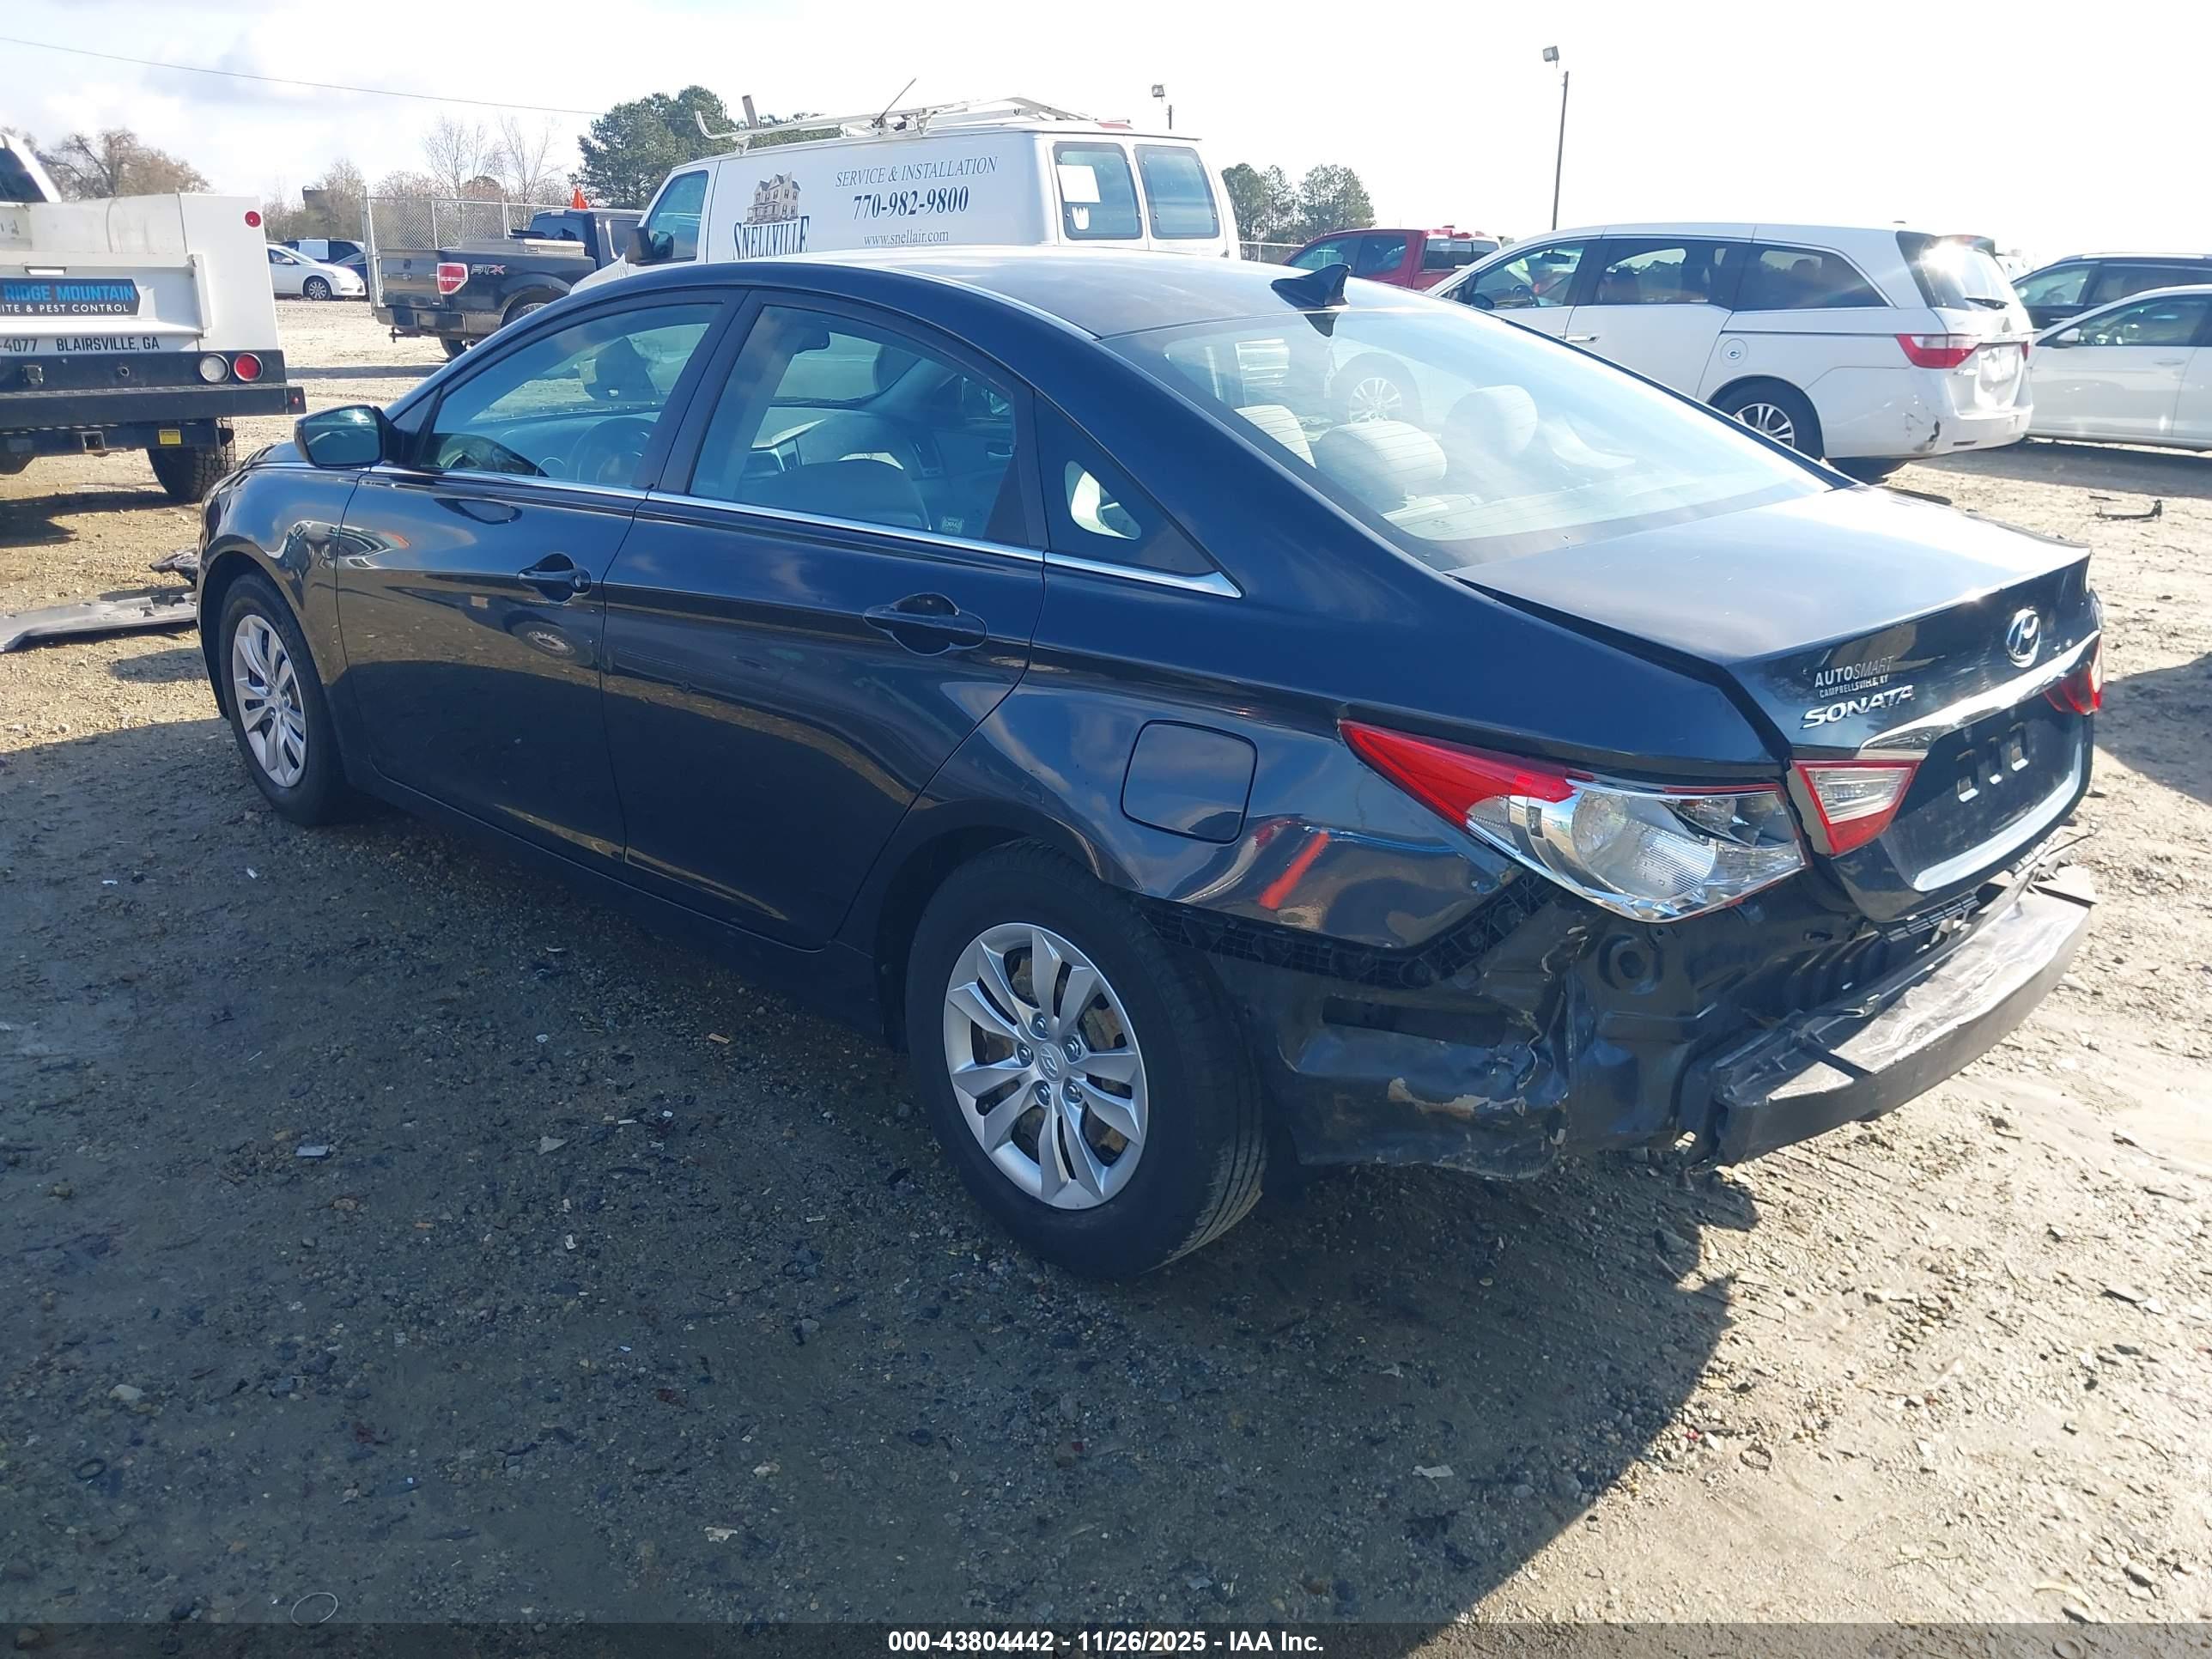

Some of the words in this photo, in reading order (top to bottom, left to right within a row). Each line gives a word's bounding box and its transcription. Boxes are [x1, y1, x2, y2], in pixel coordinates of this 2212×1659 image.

[836, 167, 886, 187] SERVICE
[888, 166, 898, 183] &
[901, 156, 999, 182] INSTALLATION
[853, 185, 969, 221] 770-982-9800
[732, 215, 811, 261] SNELLVILLE
[863, 228, 950, 247] www.snellair.com
[470, 264, 507, 276] STX
[3, 284, 52, 301] RIDGE
[55, 284, 135, 302] MOUNTAIN
[26, 304, 33, 313] &
[39, 304, 66, 313] PEST
[71, 303, 130, 313] CONTROL
[56, 336, 140, 351] BLAIRSVILLE,
[142, 336, 161, 350] GA
[1814, 655, 1895, 688] AUTOSMART
[1880, 673, 1889, 684] KY
[1802, 684, 1916, 729] SONATA
